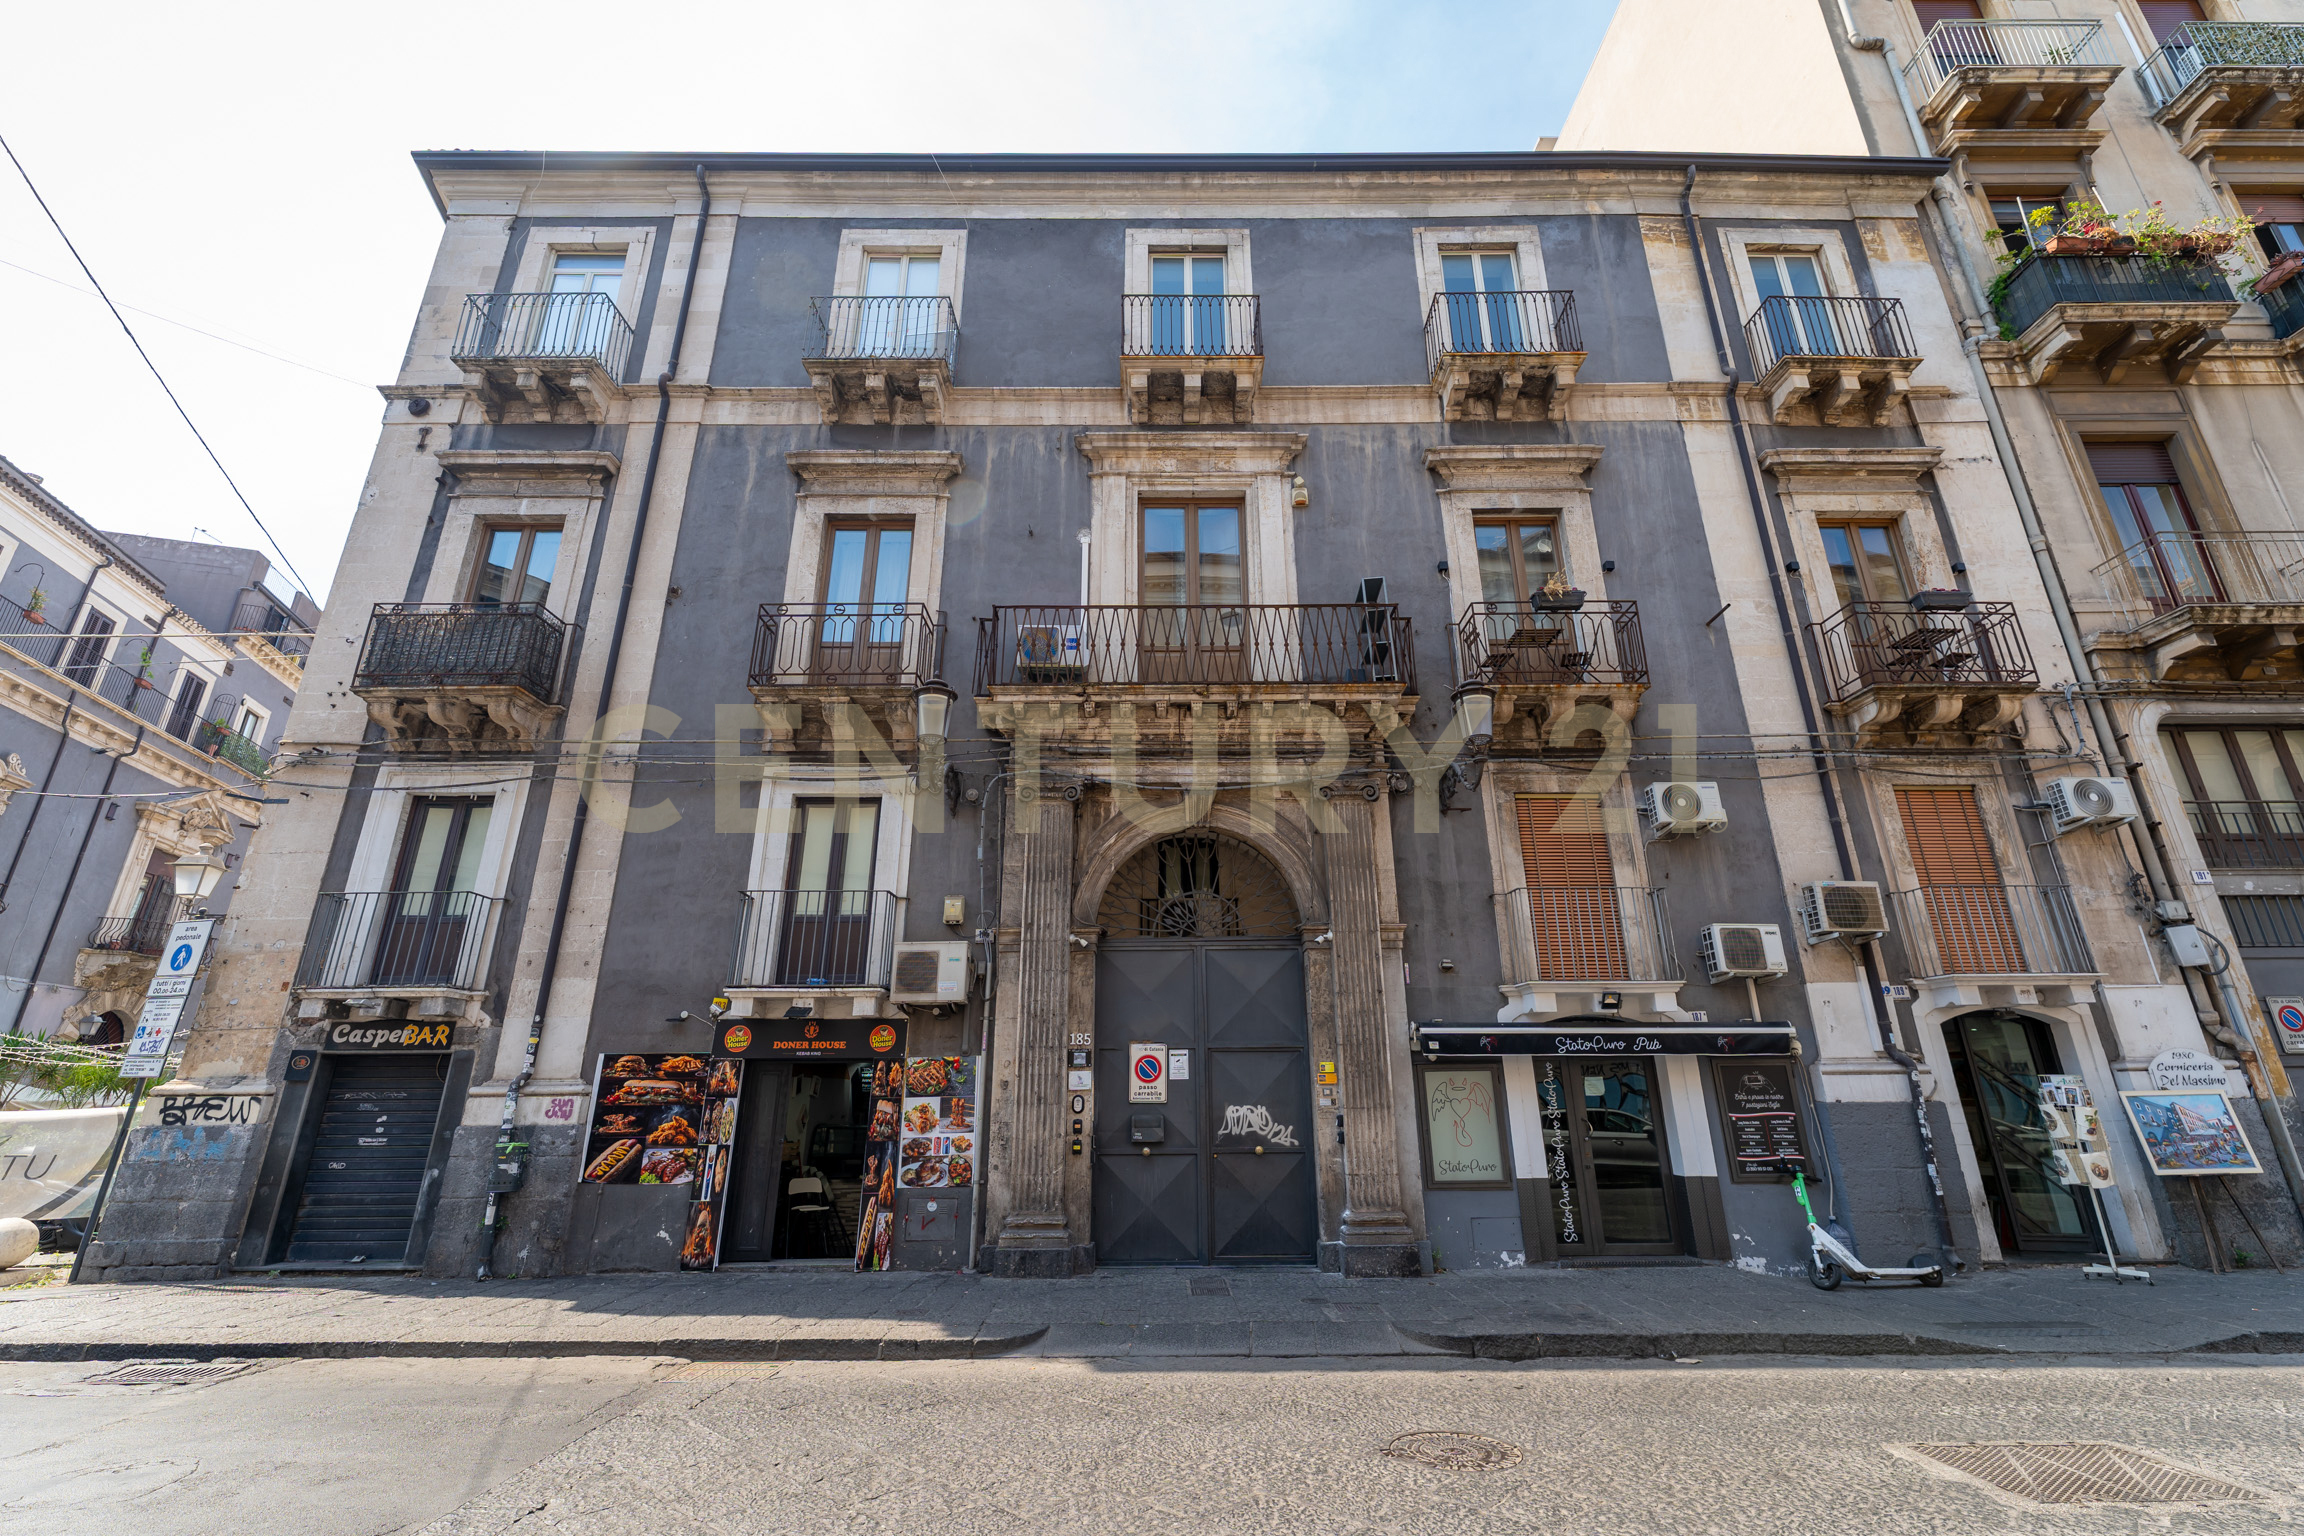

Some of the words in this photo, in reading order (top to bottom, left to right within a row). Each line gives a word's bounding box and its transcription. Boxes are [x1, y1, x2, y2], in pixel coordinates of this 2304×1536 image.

[175, 933, 202, 942] pedonale
[172, 980, 187, 988] giorni
[872, 1035, 893, 1043] Doner
[1069, 1033, 1092, 1045] 185
[727, 1041, 749, 1049] House
[773, 1041, 809, 1049] DONER
[811, 1041, 847, 1049] HOUSE
[1555, 1036, 1627, 1054] StatoPuro
[1633, 1036, 1662, 1051] Pub
[2171, 1051, 2195, 1060] 1980
[2156, 1062, 2214, 1072] Corniceria
[2159, 1074, 2179, 1087] Del
[2181, 1074, 2227, 1087] Massimo
[1438, 1159, 1497, 1175] StatoPuro
